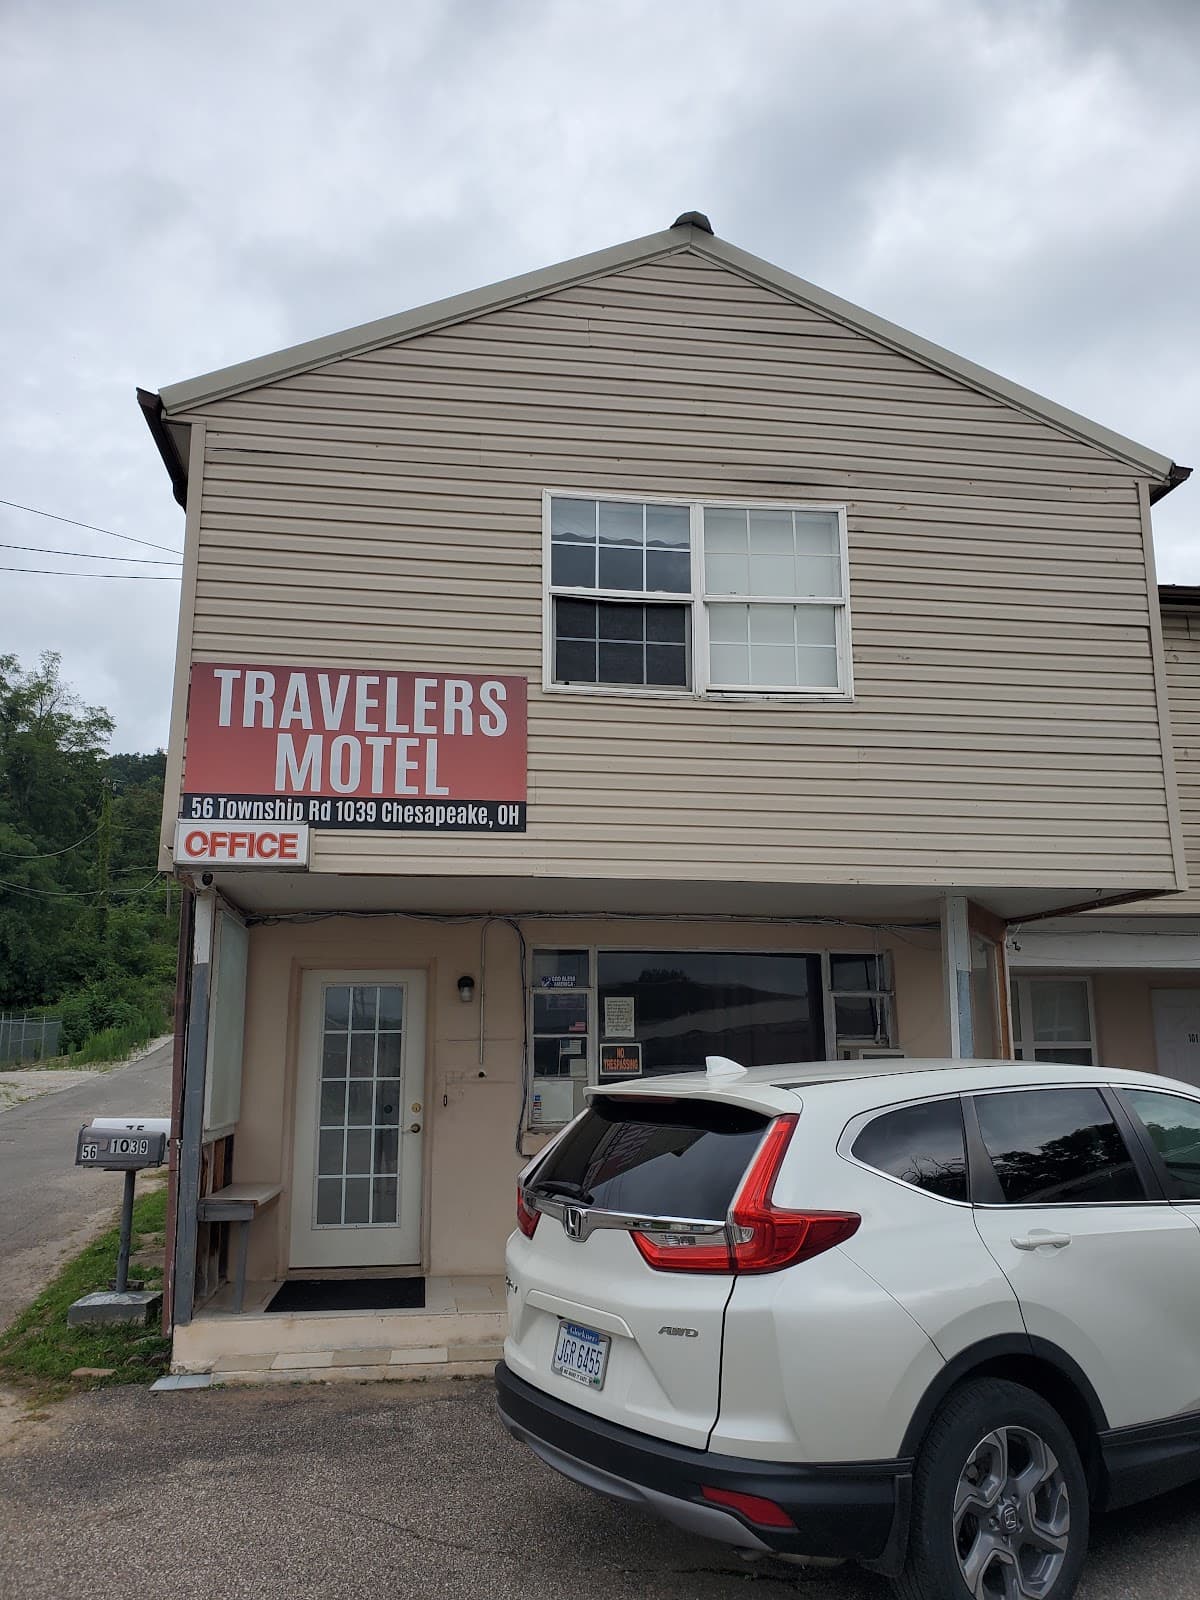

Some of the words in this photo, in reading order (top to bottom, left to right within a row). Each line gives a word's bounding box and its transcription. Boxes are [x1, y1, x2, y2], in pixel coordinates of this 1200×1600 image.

[213, 668, 508, 737] TRAVELERS
[275, 733, 449, 796] MOTEL
[191, 797, 214, 819] 56
[218, 797, 304, 821] Township
[308, 799, 331, 822] Rd
[335, 800, 377, 823] 1039
[381, 802, 494, 828] Chesapeake,
[497, 804, 519, 826] OH
[185, 831, 299, 859] OFFICE
[616, 1047, 625, 1059] NO
[604, 1058, 639, 1070] TRESPASSING
[82, 1145, 97, 1158] 56
[112, 1139, 147, 1153] 1039
[658, 1326, 699, 1338] AWD
[557, 1338, 577, 1368] JGR
[576, 1344, 603, 1376] 6455
